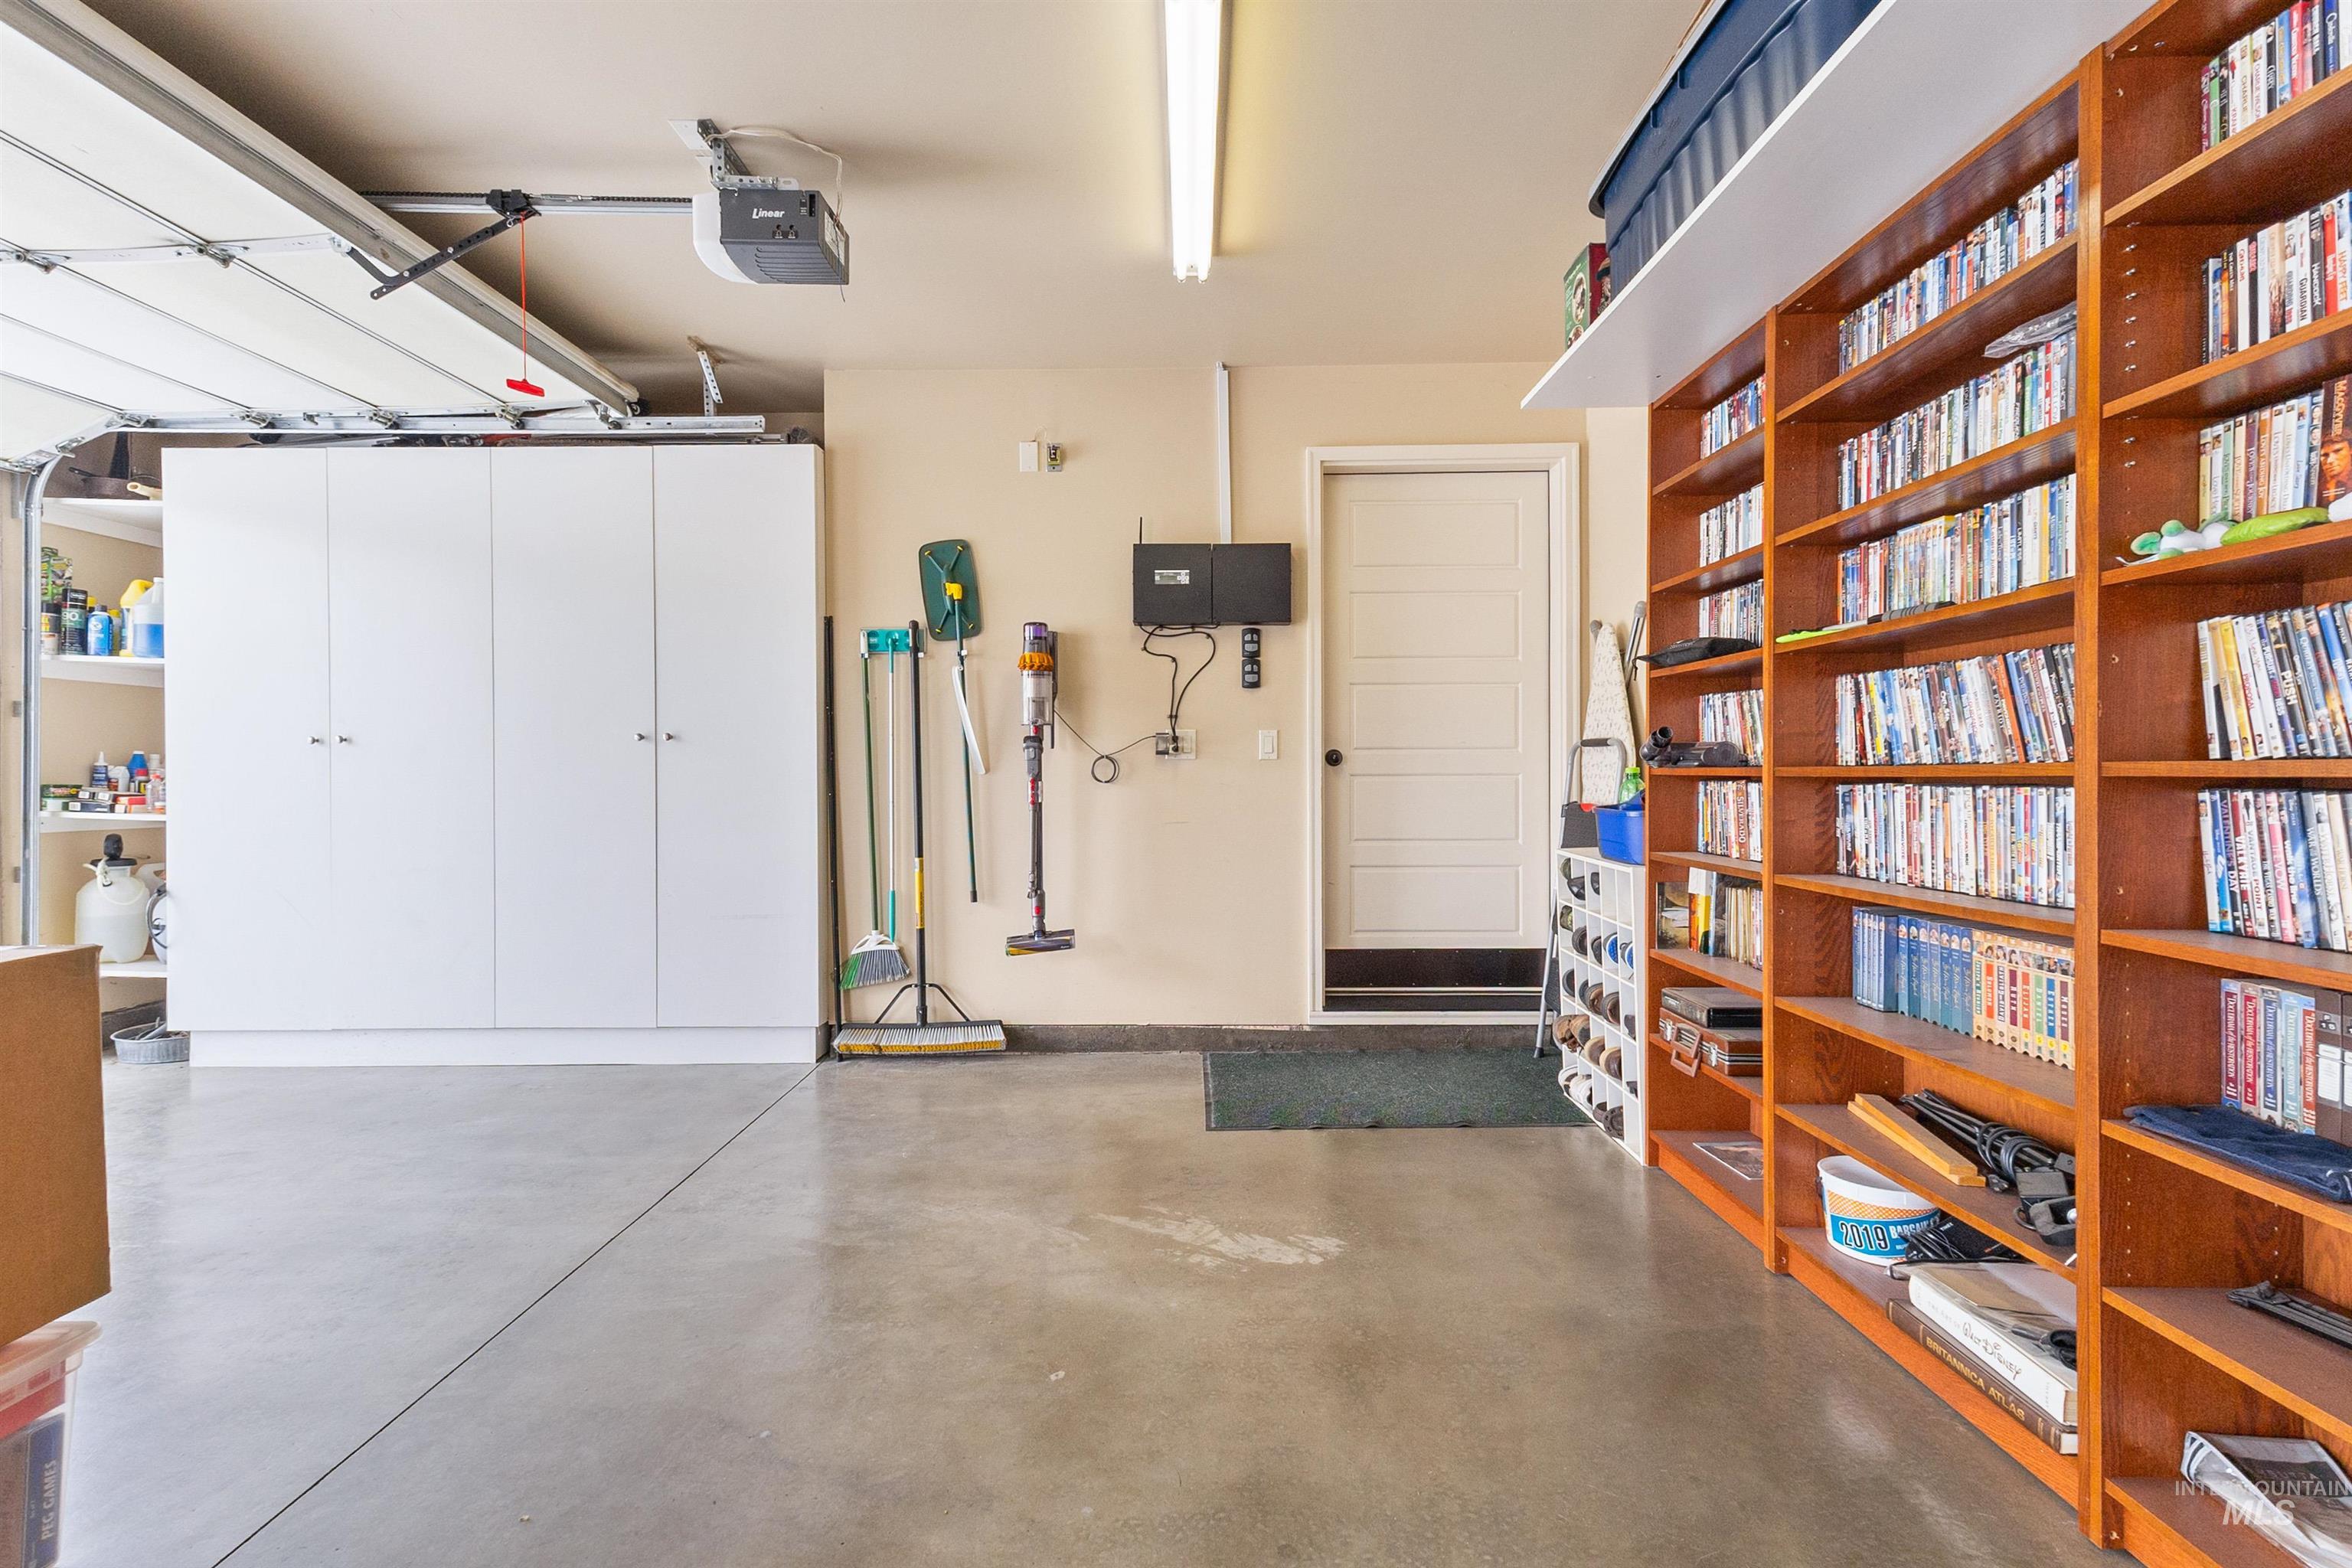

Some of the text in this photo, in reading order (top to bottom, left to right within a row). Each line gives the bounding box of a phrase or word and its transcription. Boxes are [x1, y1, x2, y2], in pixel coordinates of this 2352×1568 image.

[752, 208, 785, 219] Linear
[2299, 277, 2308, 322] GUARDIAN
[2312, 262, 2321, 307] HANCOCK
[2263, 646, 2275, 680] PURSUIT
[2243, 673, 2255, 710] PROPOSAL
[2281, 670, 2298, 705] PUSH
[1737, 796, 1746, 844] SILVERADO
[2220, 799, 2239, 893] VALENTINE'S DAY
[2235, 835, 2249, 890] VALKYRIE
[2285, 840, 2293, 864] walk
[2306, 827, 2322, 896] WAR WORLDS
[2246, 829, 2262, 910] VANTAGE POINT
[2275, 862, 2285, 890] VOW
[2287, 864, 2295, 883] the
[1839, 1220, 1890, 1251] 2019
[1962, 1322, 2022, 1380] WALT DISNEY
[1926, 1337, 2026, 1422] BRITANNICA ATLAS
[41, 1459, 57, 1541] PEG GAMES
